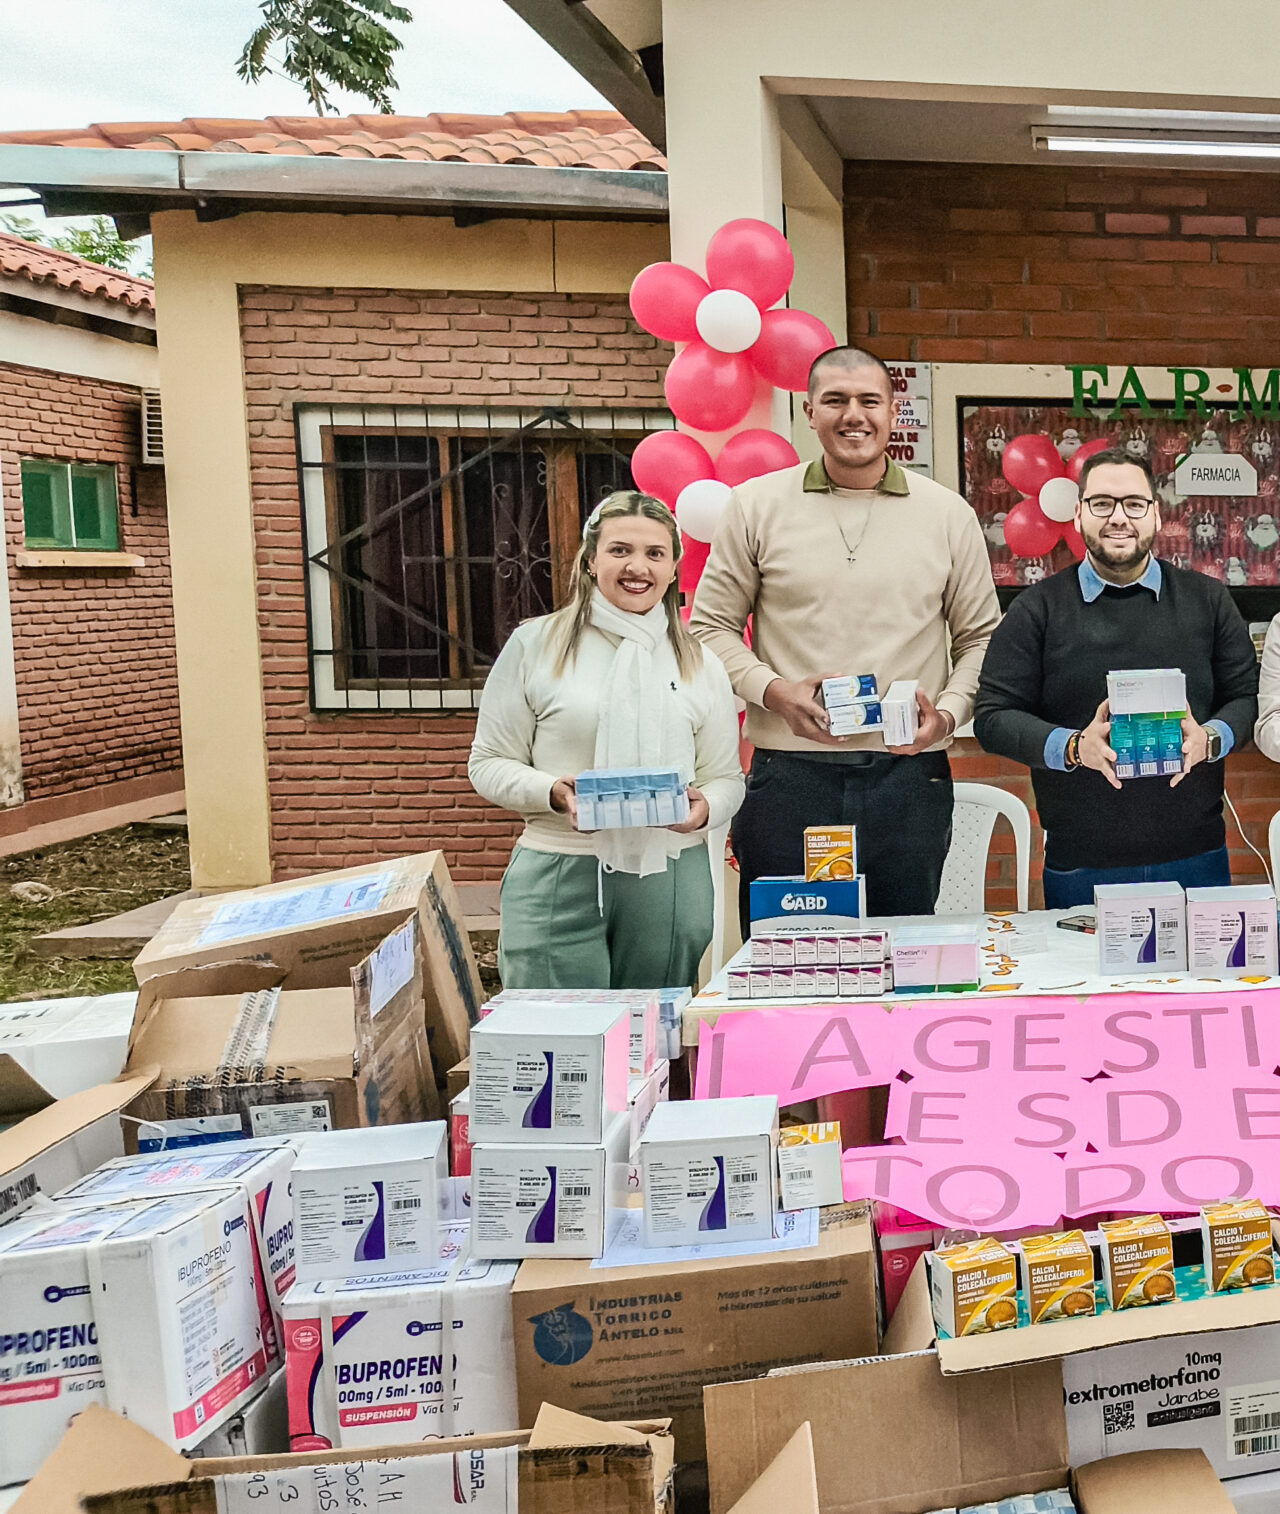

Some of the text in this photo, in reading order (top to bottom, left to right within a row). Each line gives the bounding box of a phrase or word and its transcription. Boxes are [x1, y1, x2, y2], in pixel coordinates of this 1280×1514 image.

[905, 367, 916, 378] DE
[907, 432, 918, 442] DE
[1190, 467, 1242, 482] FARMACIA
[1213, 1226, 1244, 1238] CALCIO Y
[1213, 1231, 1269, 1246] COLECALCIFEROL
[1112, 1242, 1143, 1255] CALCIO Y
[1113, 1246, 1170, 1263] COLECALCIFEROL
[178, 1240, 232, 1281] IBUPROFENO
[956, 1270, 987, 1284] CALCIO Y
[1031, 1264, 1061, 1276] CALCIO Y
[1032, 1269, 1085, 1284] COLECALCIFEROL
[957, 1272, 1013, 1292] COLECALCIFEROL
[589, 1291, 683, 1312] INDUSTRIAS
[595, 1309, 672, 1327] TORRICO
[599, 1327, 659, 1342] ANTELO
[62, 1353, 102, 1370] 100m
[338, 1387, 374, 1403] 00mg
[385, 1384, 408, 1398] 5ml
[1062, 1367, 1221, 1406] extrometorfano
[1158, 1387, 1221, 1408] Jarabe
[344, 1406, 411, 1423] SUSPENSIÓN
[378, 1473, 405, 1486] A
